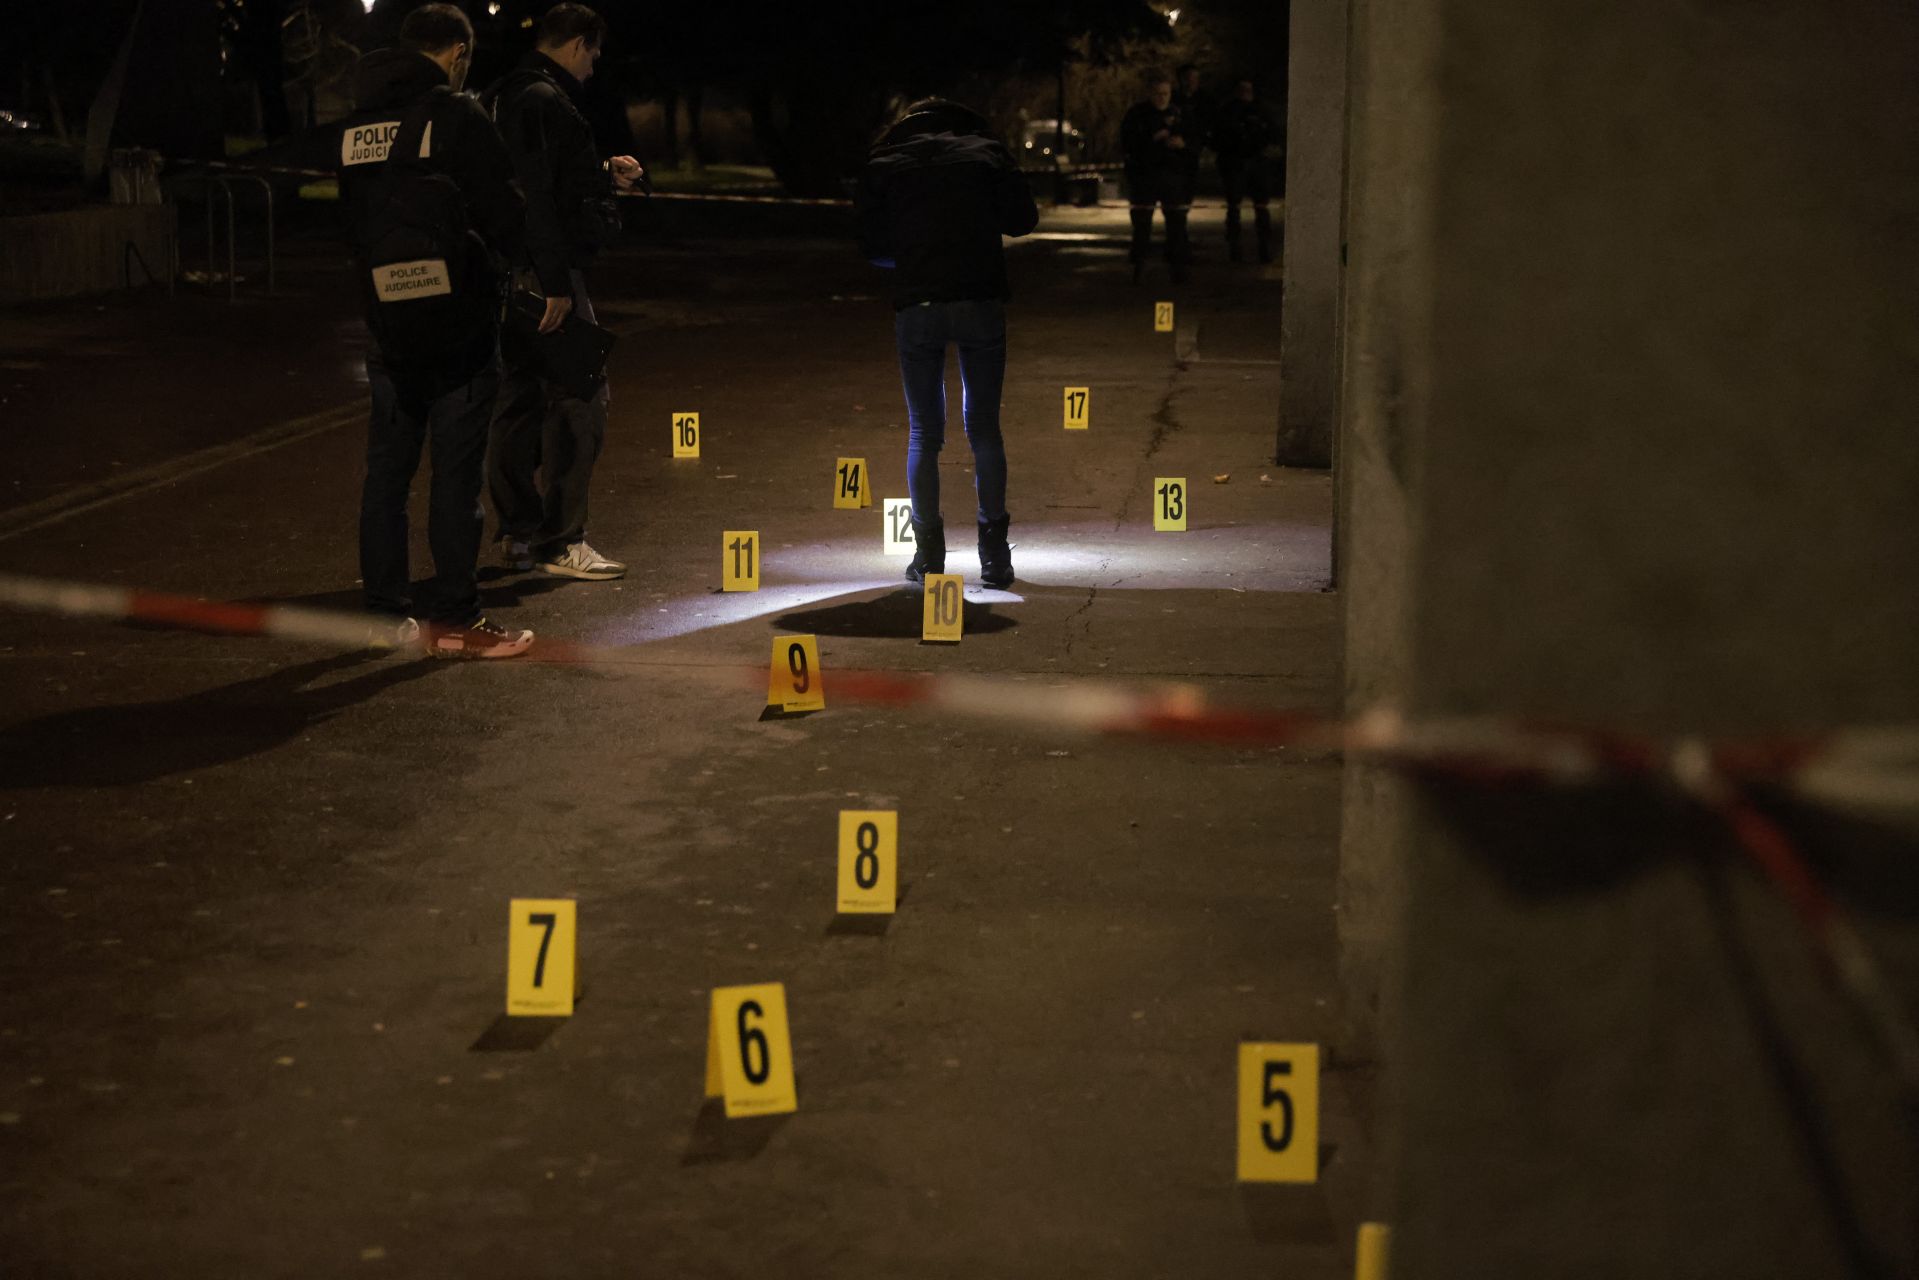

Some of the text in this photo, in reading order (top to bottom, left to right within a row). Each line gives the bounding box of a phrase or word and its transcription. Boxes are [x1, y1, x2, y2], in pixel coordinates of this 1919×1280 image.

[350, 146, 387, 161] JUDICI
[353, 125, 399, 147] POLIC
[384, 276, 441, 292] JUDICIAIRE
[390, 266, 429, 279] POLICE
[1157, 306, 1171, 325] 21
[1067, 391, 1086, 419] 17
[675, 417, 696, 447] 16
[838, 463, 860, 499] 14
[1157, 483, 1182, 521] 13
[887, 504, 913, 543] 12
[728, 536, 753, 579] 11
[927, 579, 957, 626] 10
[788, 642, 810, 695] 9
[855, 820, 879, 890] 8
[528, 912, 557, 988] 7
[737, 999, 771, 1086] 6
[1260, 1060, 1294, 1152] 5
